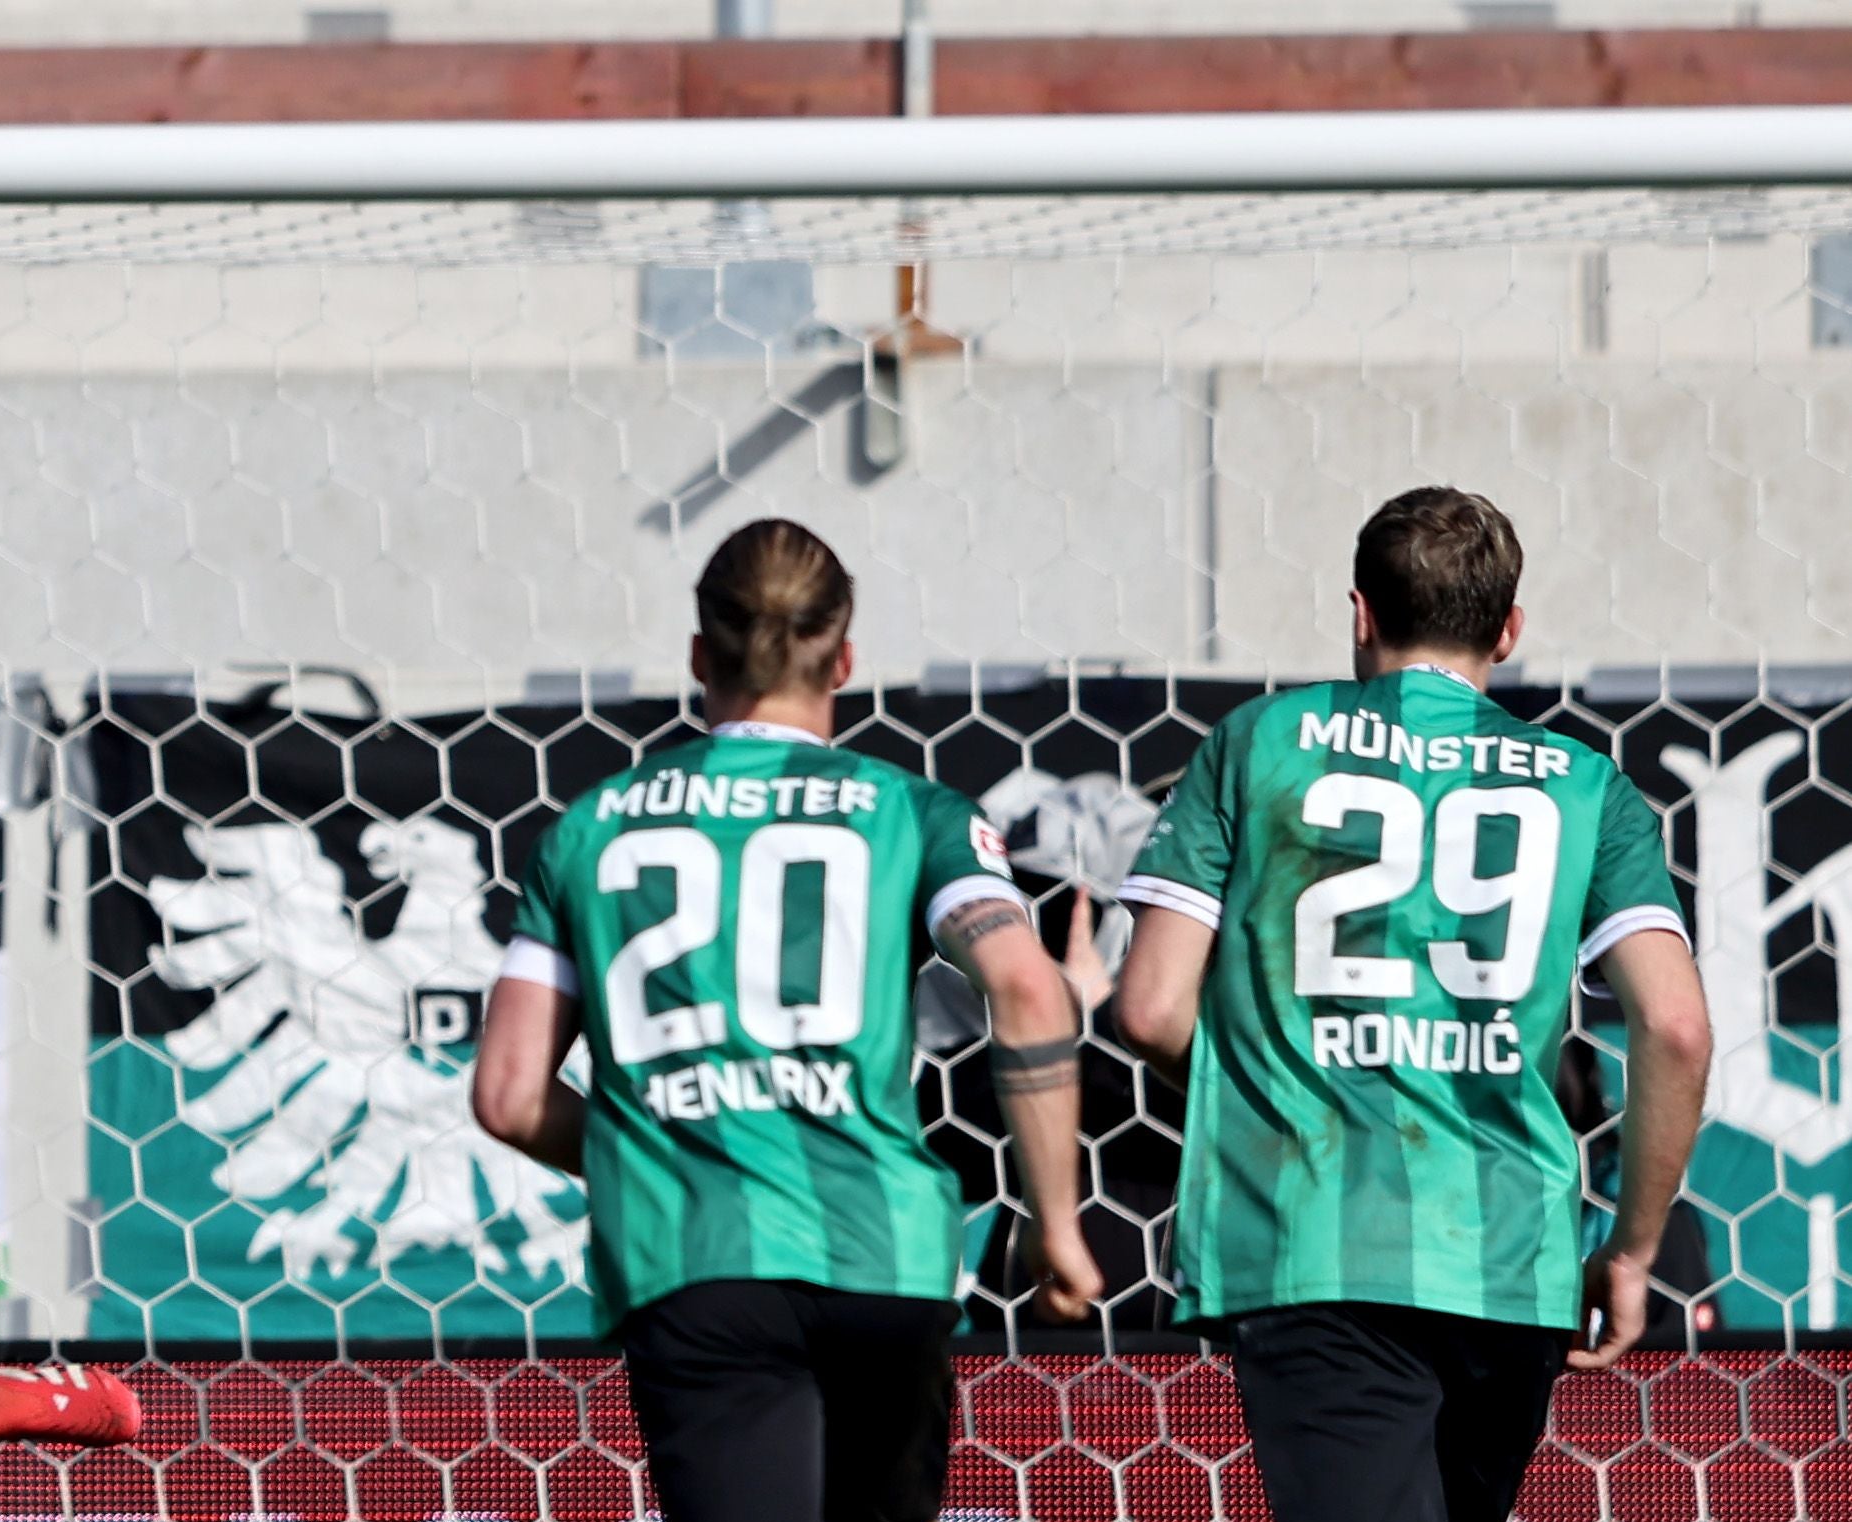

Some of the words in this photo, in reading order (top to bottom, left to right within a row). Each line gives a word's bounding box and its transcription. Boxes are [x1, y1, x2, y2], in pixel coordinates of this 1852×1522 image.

[1299, 711, 1570, 779] MÜNSTER
[597, 768, 878, 820] MÜNSTER
[1294, 773, 1563, 1000] 29
[597, 824, 871, 1064] 20
[1312, 1010, 1521, 1075] RONDIĆ
